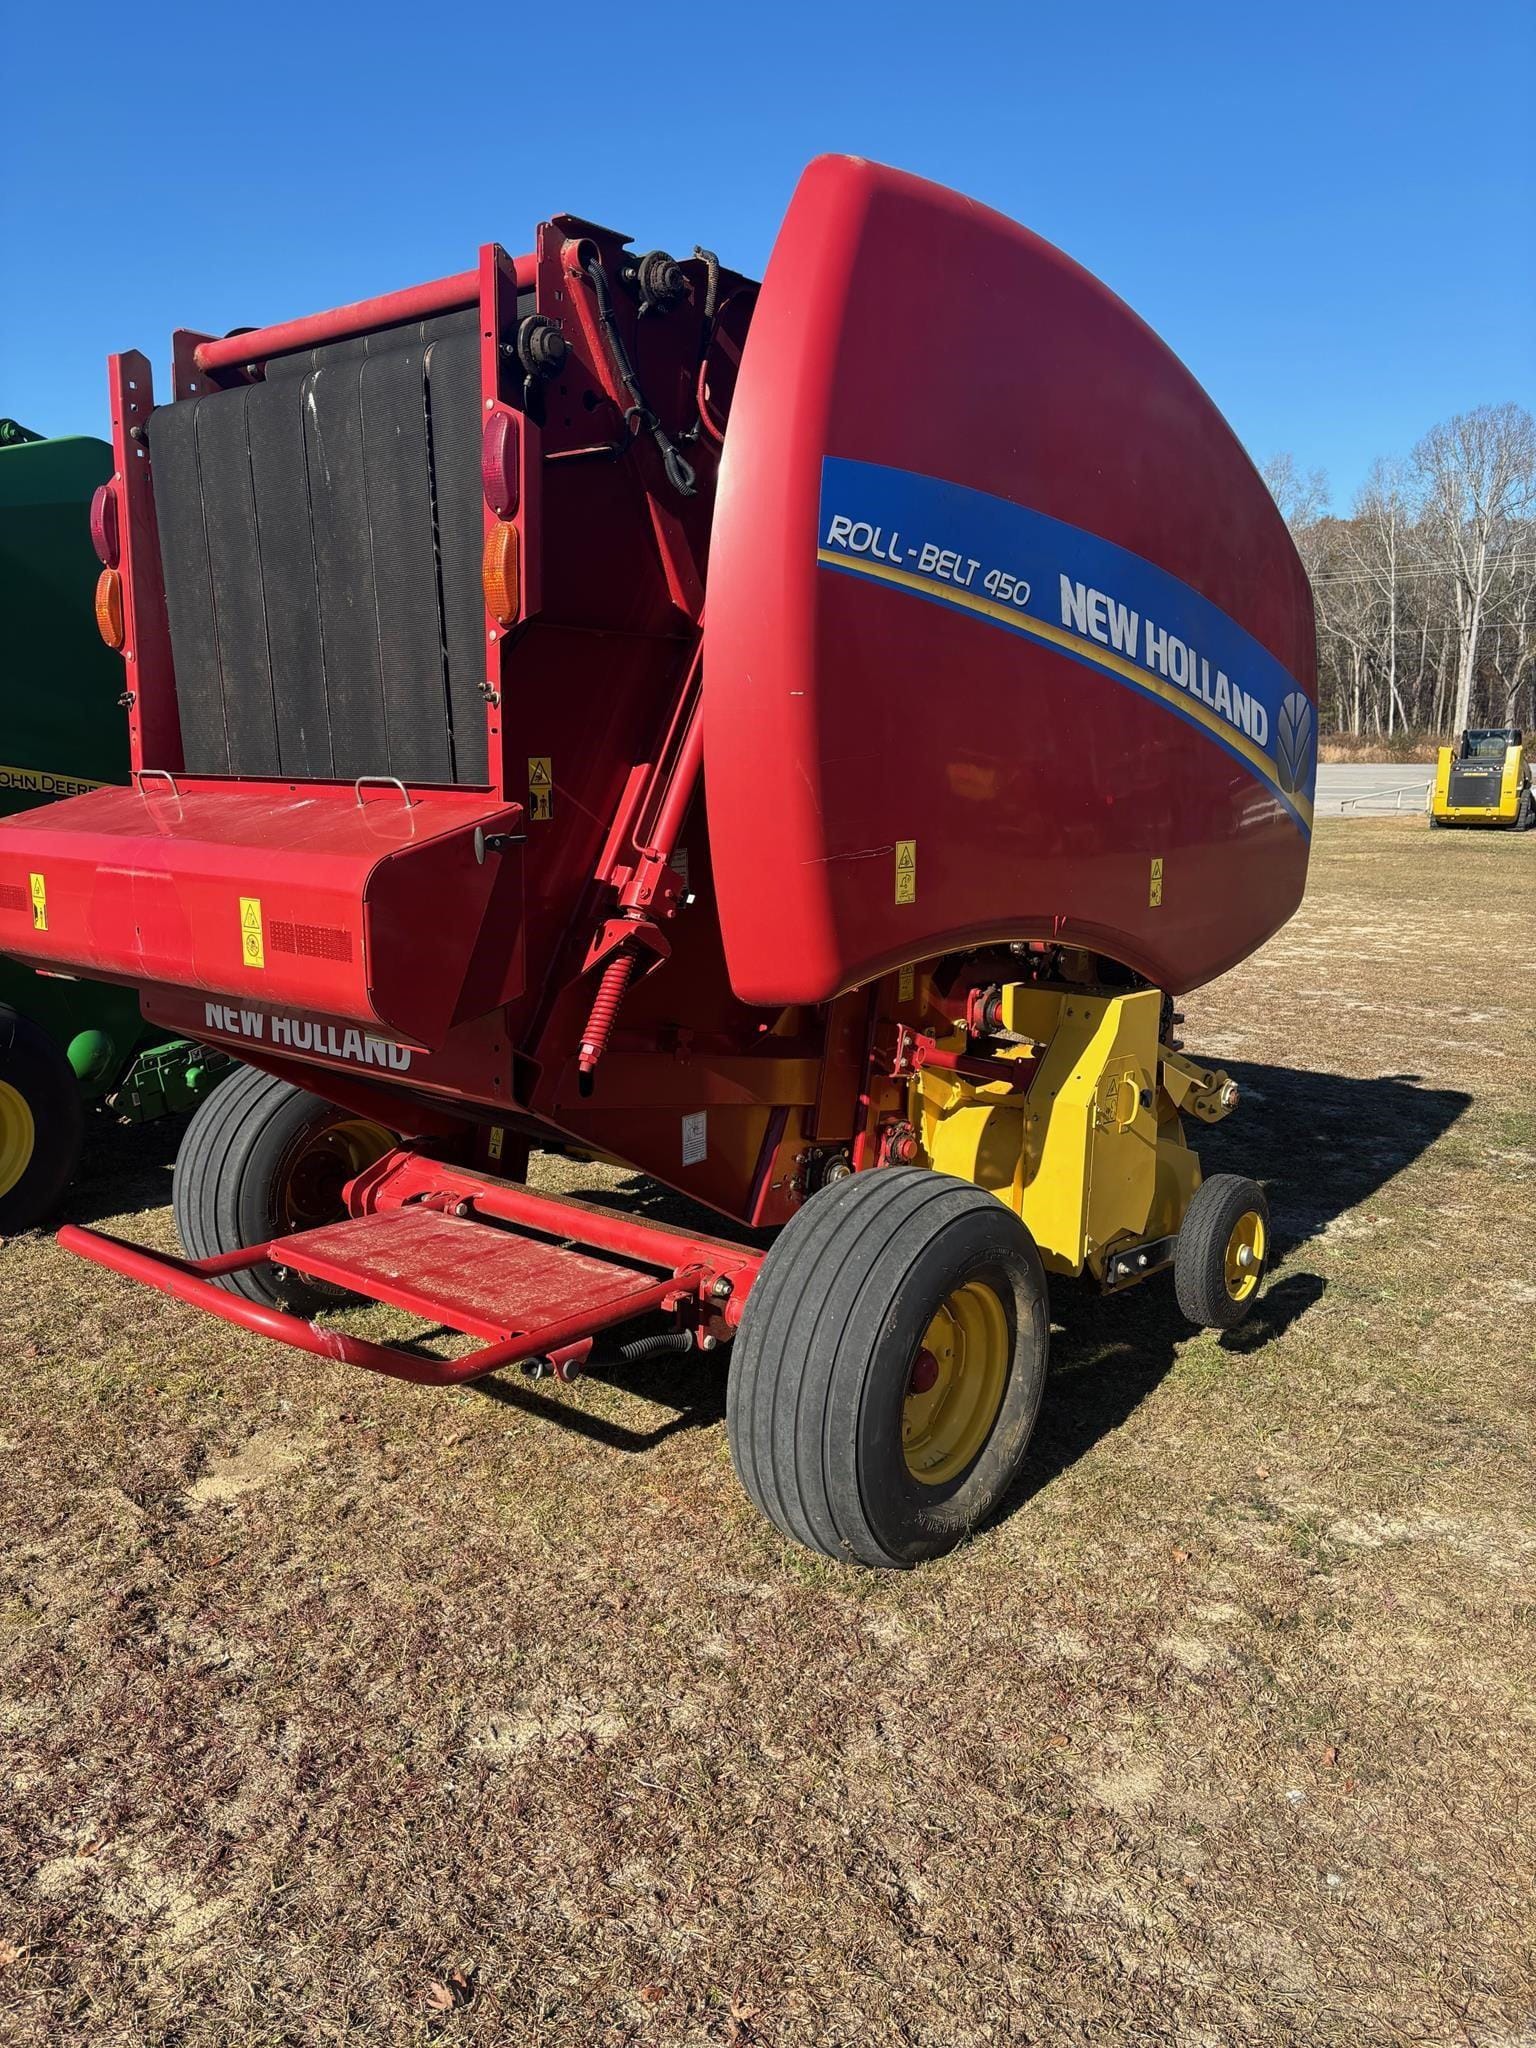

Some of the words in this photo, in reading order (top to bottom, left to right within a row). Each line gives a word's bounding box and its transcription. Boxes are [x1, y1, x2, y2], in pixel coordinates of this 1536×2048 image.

[983, 569, 1031, 606] 450
[1059, 572, 1139, 659] NEW
[1145, 618, 1269, 747] HOLLAND
[0, 772, 37, 789] OHN
[204, 1001, 264, 1039] NEW
[271, 1015, 411, 1071] HOLLAND
